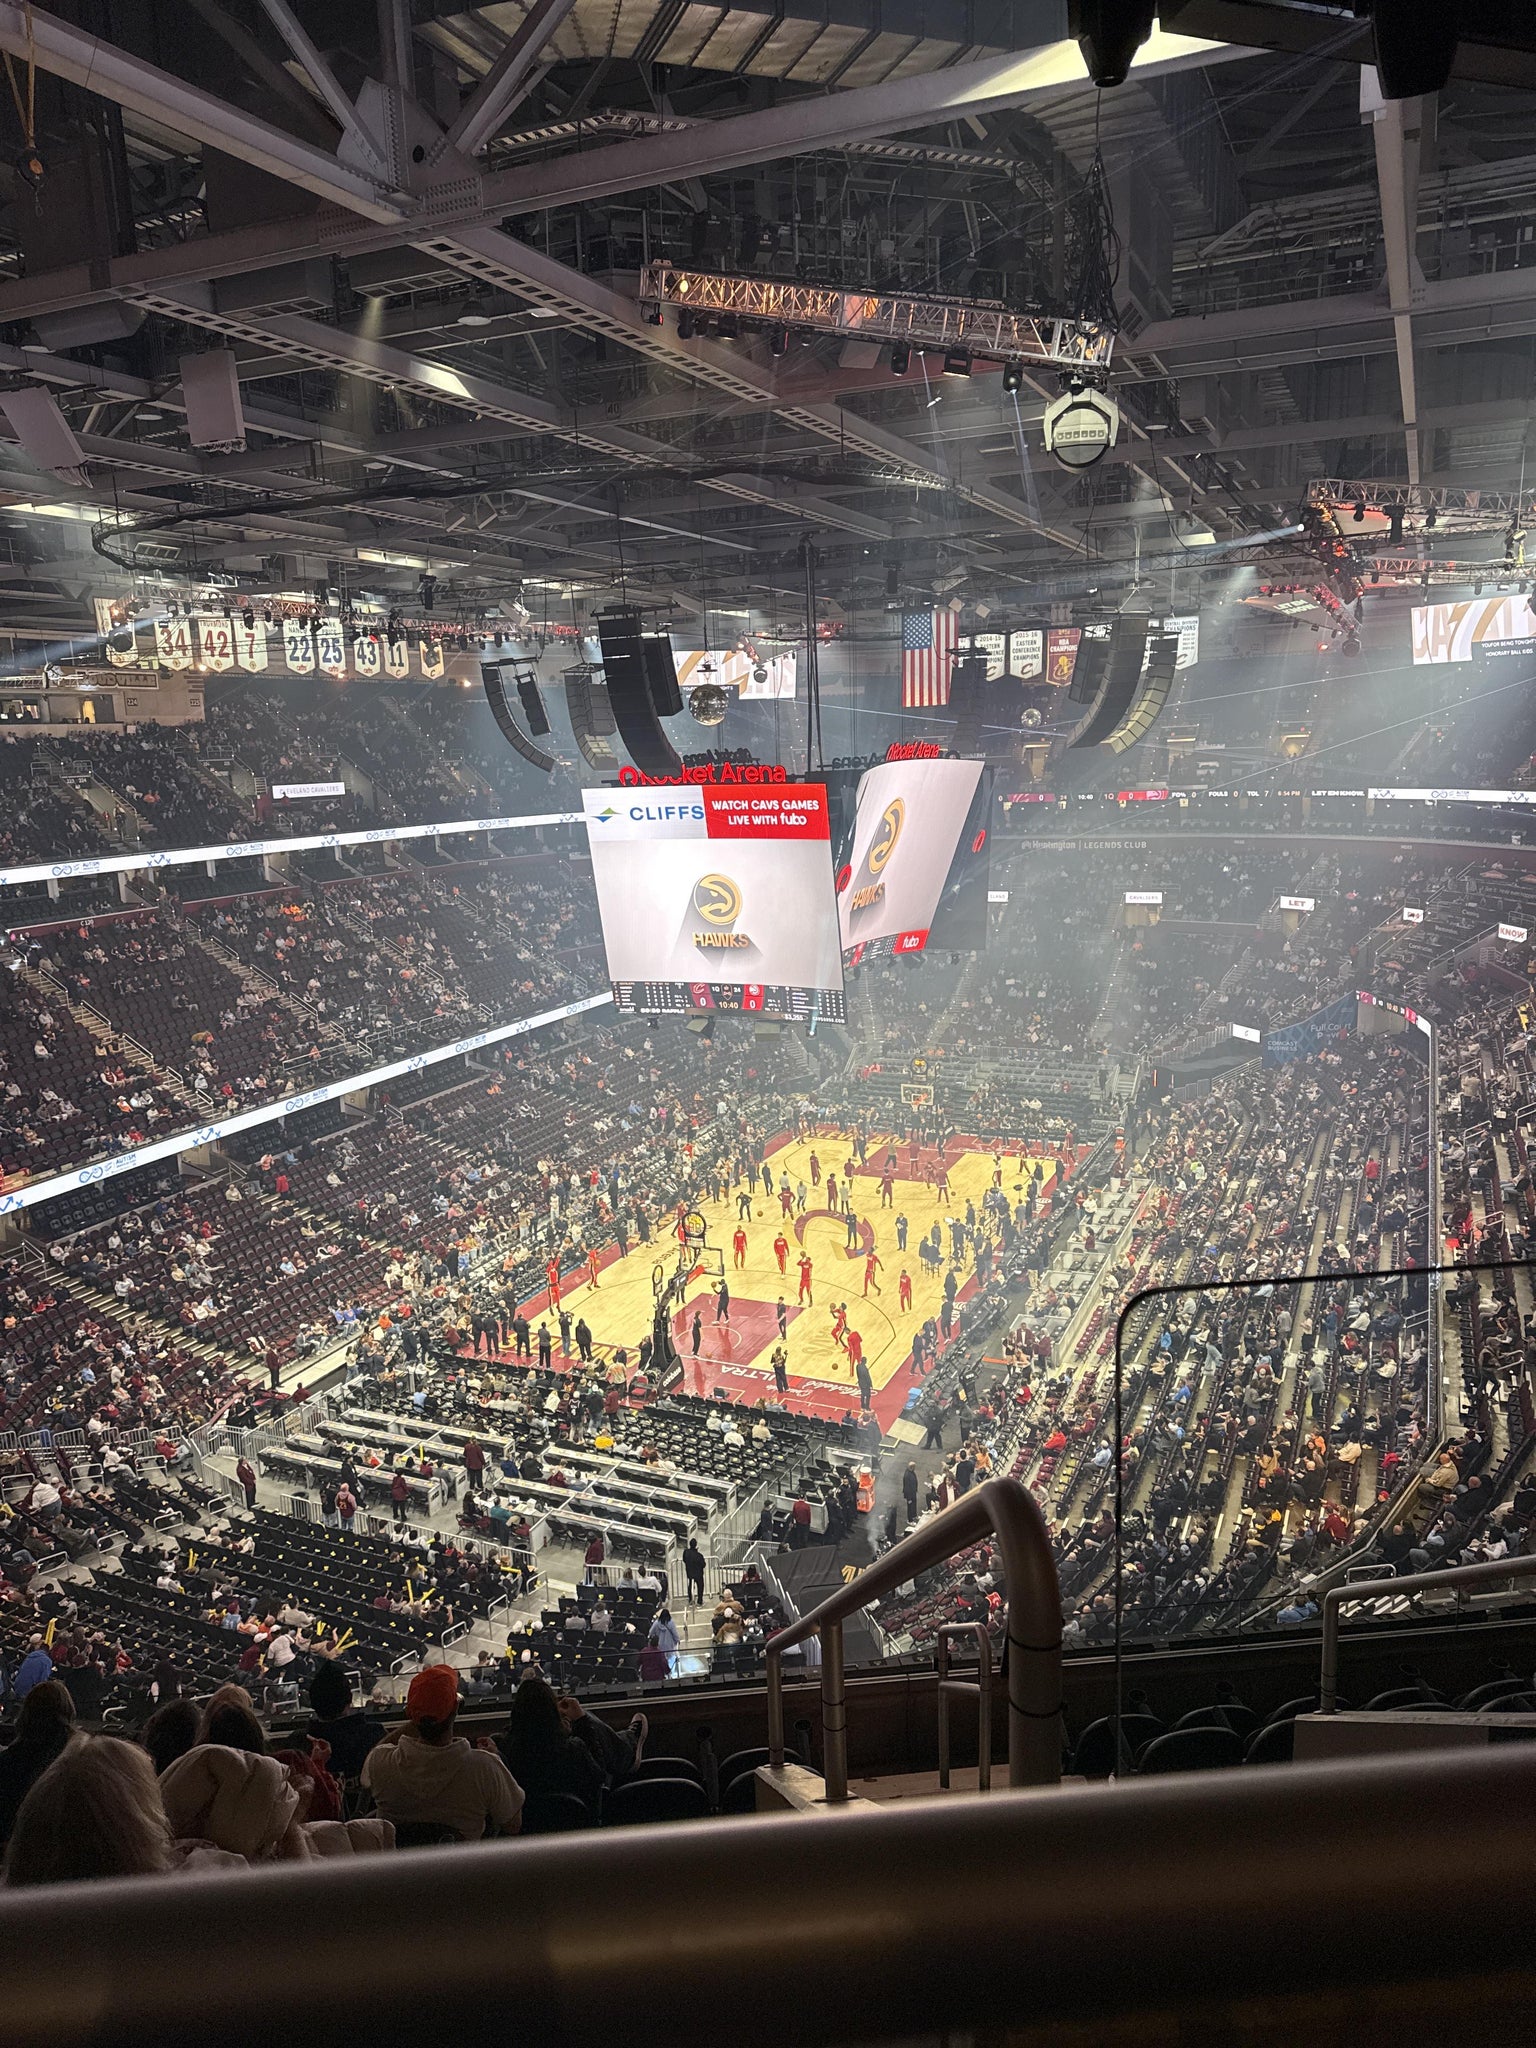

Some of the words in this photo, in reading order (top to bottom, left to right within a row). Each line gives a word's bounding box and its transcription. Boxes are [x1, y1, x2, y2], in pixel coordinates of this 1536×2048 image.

[1015, 631, 1038, 639] 2015-16
[160, 628, 189, 656] 34
[204, 629, 230, 658] 42
[244, 632, 255, 659] 7
[1058, 638, 1070, 646] NBA
[287, 635, 312, 662] 22
[320, 637, 343, 664] 25
[357, 640, 377, 666] 43
[1012, 646, 1041, 654] CONFERENCE
[1050, 645, 1078, 653] CHAMPIONS
[388, 644, 405, 667] 11
[1013, 653, 1040, 661] CHAMPIONS
[916, 740, 940, 758] Arena
[640, 763, 717, 785] Rket
[720, 761, 788, 784] Arena
[1038, 794, 1044, 802] 0
[1128, 792, 1134, 800] 0
[1191, 791, 1197, 799] 0
[711, 799, 749, 811] WATCH
[751, 799, 780, 811] CAVS
[781, 799, 820, 811] GAMES
[629, 804, 705, 822] CLIFFS
[727, 815, 750, 826] LIVE
[751, 815, 778, 826] WITH
[779, 812, 808, 826] fubo
[1084, 841, 1122, 849] LEGENDS
[1124, 841, 1147, 849] CLUB
[852, 882, 886, 911] HAWKS
[1288, 900, 1306, 908] LET
[1499, 926, 1526, 939] KNOW
[692, 931, 750, 948] HAWKS
[902, 935, 920, 949] fubo
[700, 997, 707, 1007] 0
[719, 1001, 739, 1010] 10:40
[749, 999, 756, 1009] 0
[1310, 1024, 1327, 1032] Full
